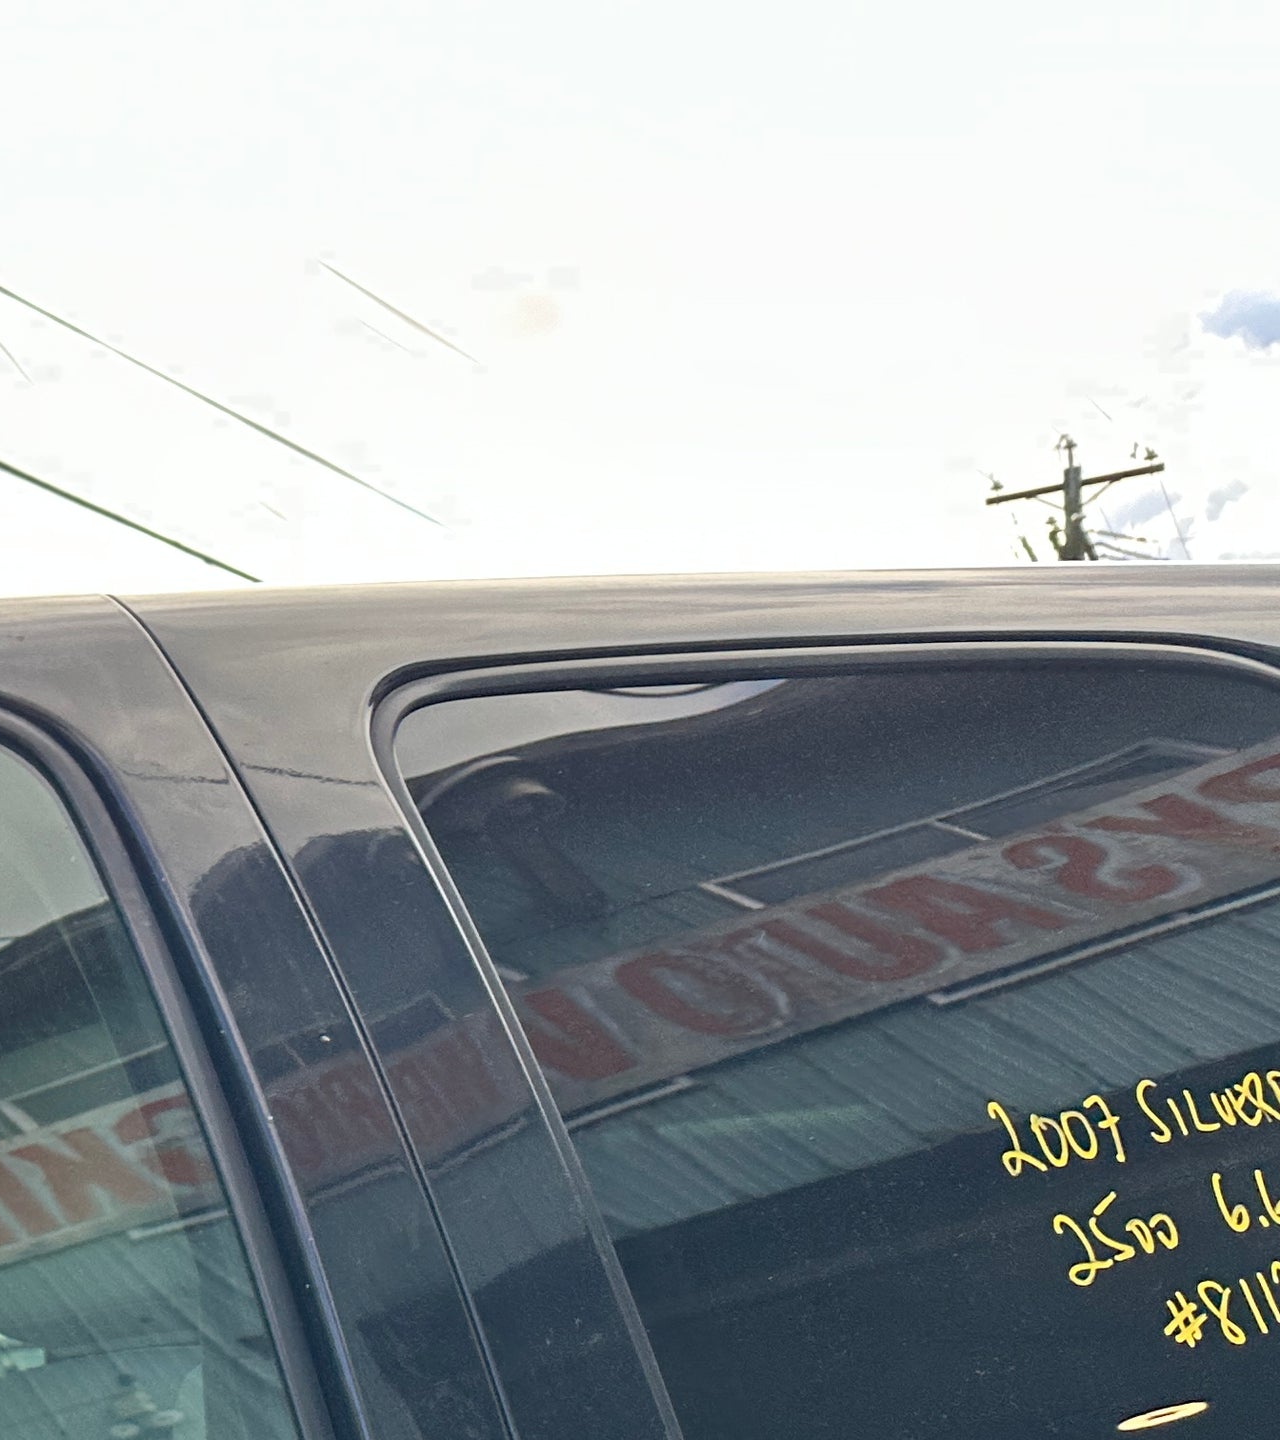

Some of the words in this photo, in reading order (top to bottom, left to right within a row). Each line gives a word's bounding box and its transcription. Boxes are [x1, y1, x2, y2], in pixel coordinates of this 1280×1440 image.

[987, 1094, 1126, 1177] 2007
[1052, 1190, 1180, 1287] 2500
[1163, 1260, 1280, 1348] #811
